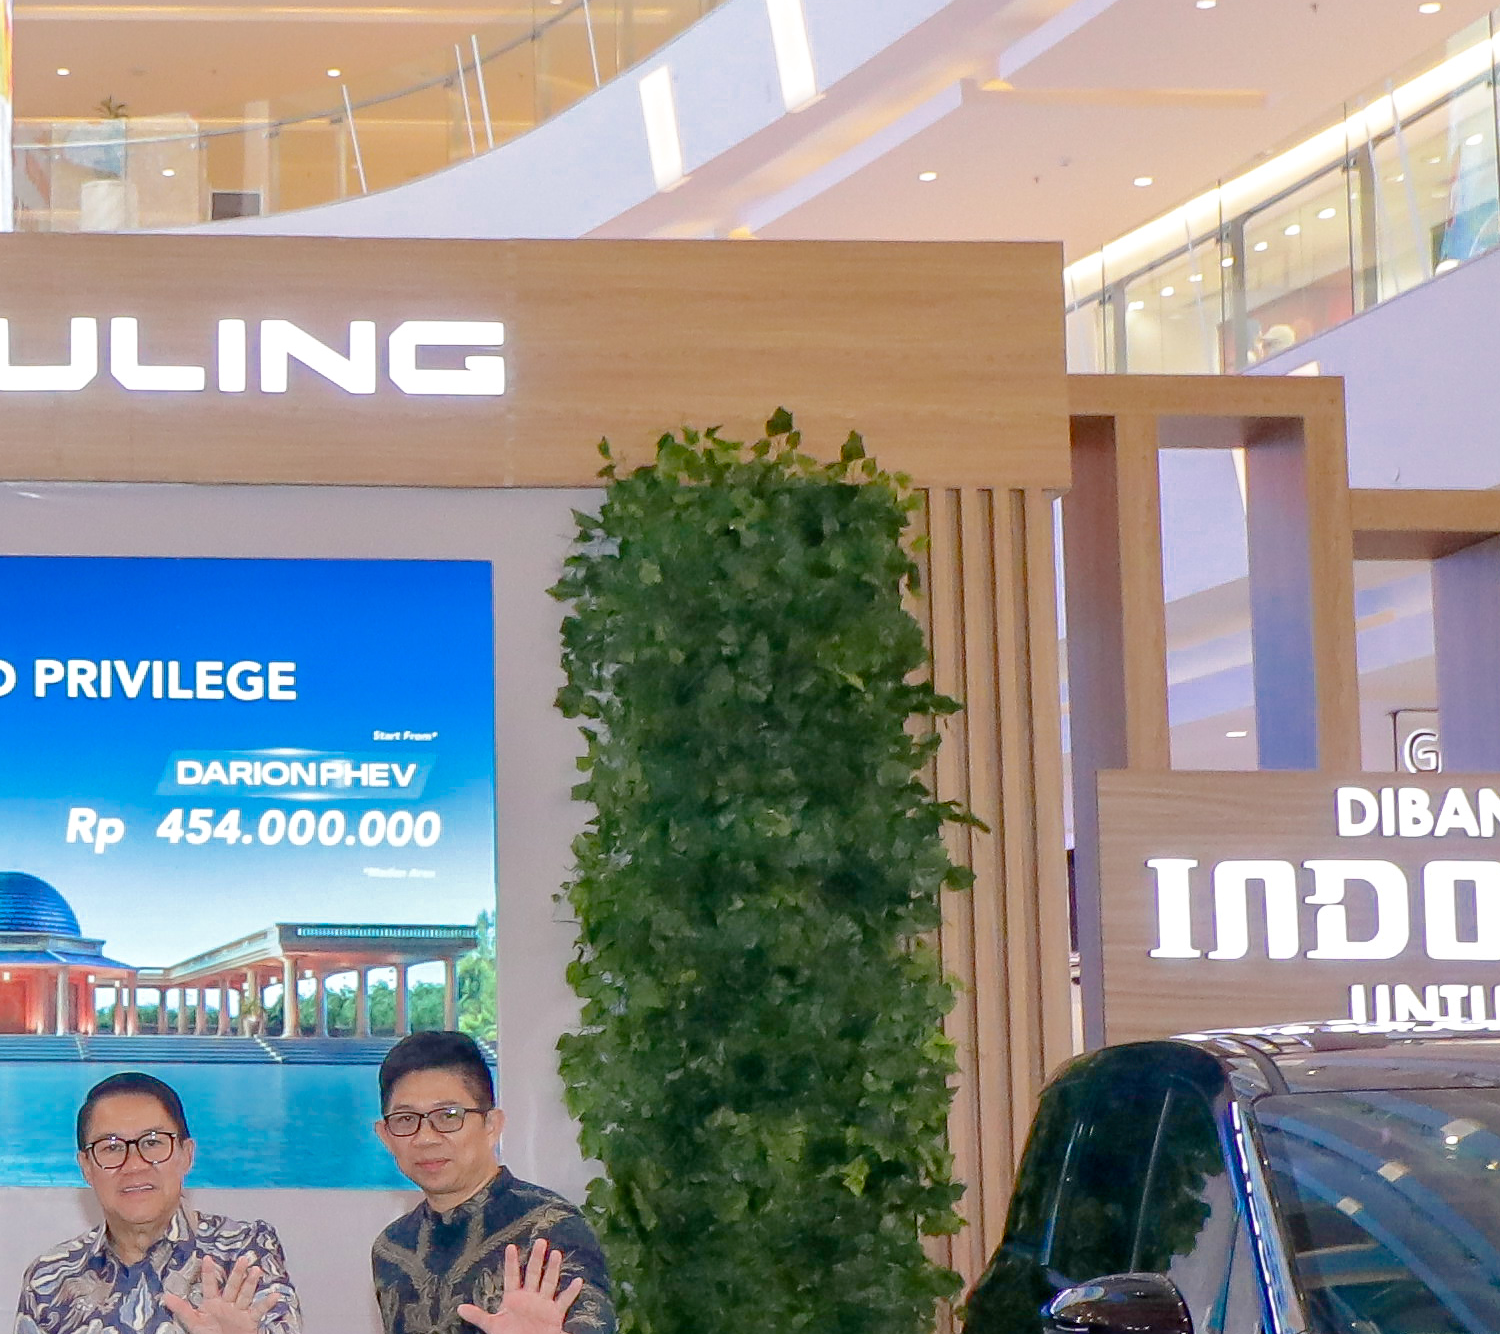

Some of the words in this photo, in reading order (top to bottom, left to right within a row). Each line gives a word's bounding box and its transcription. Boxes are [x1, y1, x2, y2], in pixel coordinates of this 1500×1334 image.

[34, 659, 298, 702] PRIVILEGE
[66, 807, 125, 855] Rp
[156, 808, 441, 848] 454.000.000
